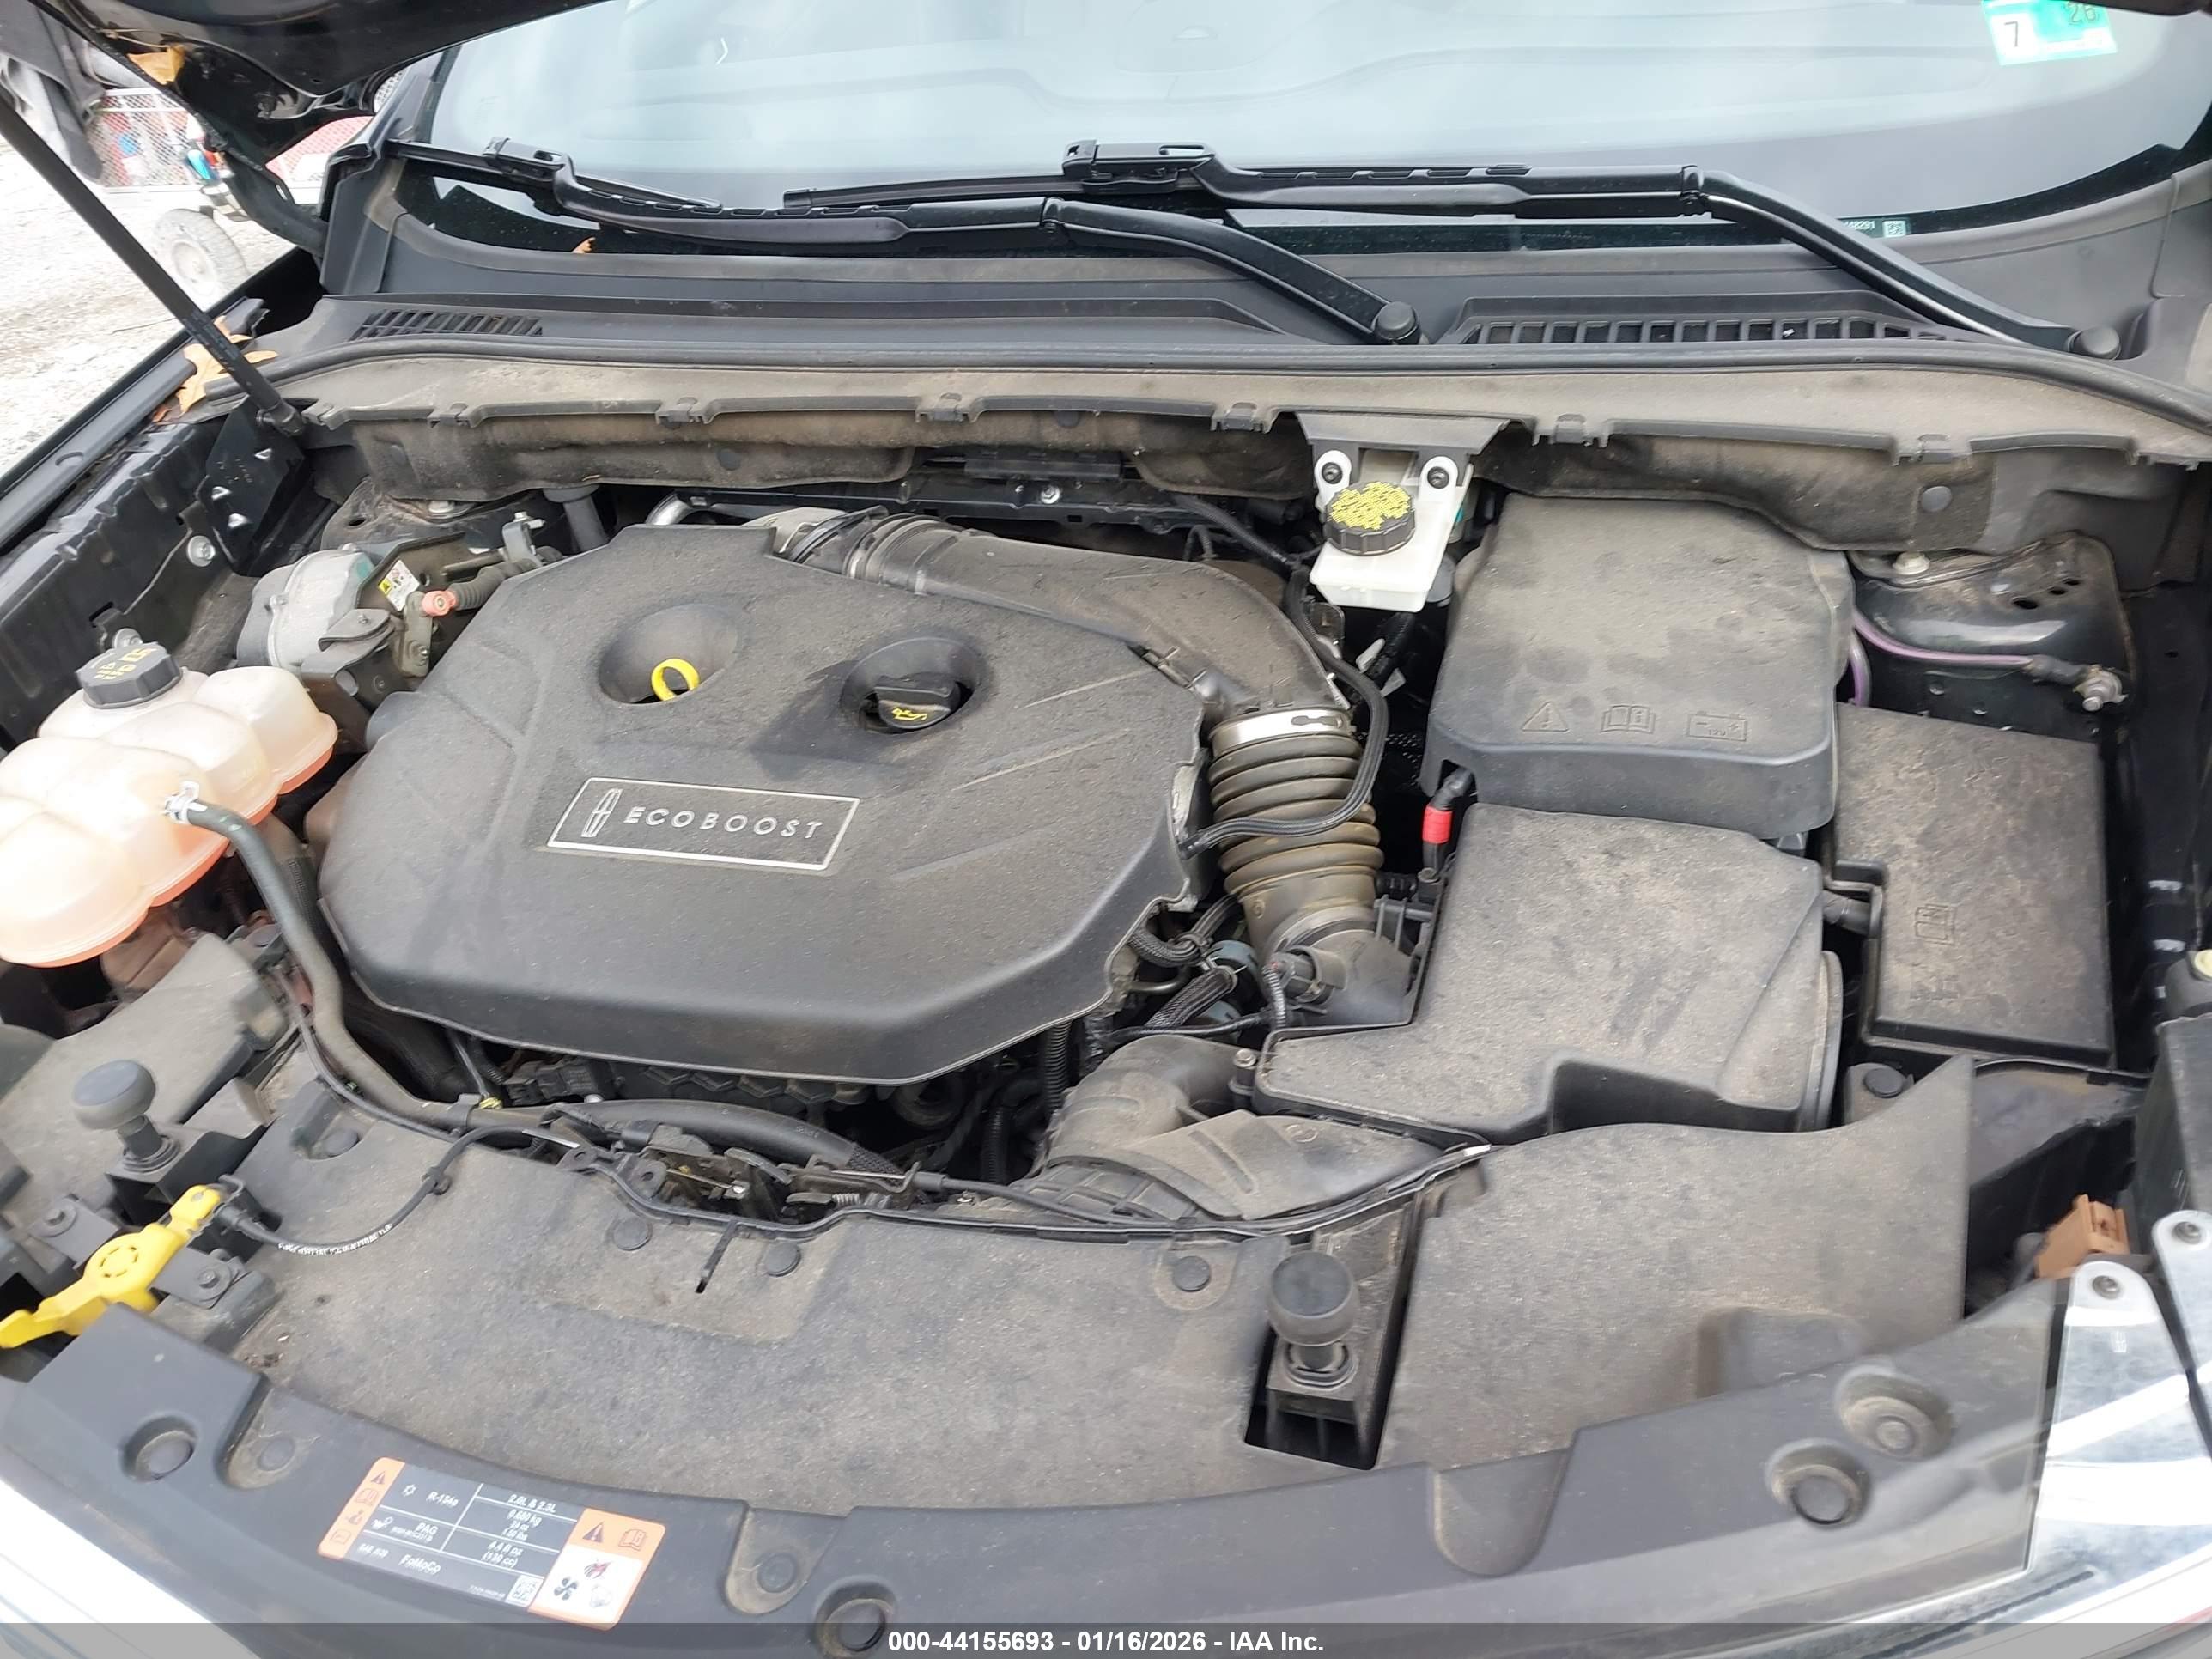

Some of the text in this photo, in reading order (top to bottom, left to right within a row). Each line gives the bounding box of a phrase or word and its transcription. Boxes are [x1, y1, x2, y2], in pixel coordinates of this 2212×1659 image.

[2067, 2, 2099, 25] 26
[2004, 21, 2019, 47] 7
[623, 806, 823, 840] ECOBOOST
[507, 1494, 527, 1507] 2.0L
[536, 1501, 556, 1513] 2.3L
[416, 1522, 439, 1536] PAG
[529, 1514, 543, 1528] kg
[398, 1554, 441, 1575] FoMoCo
